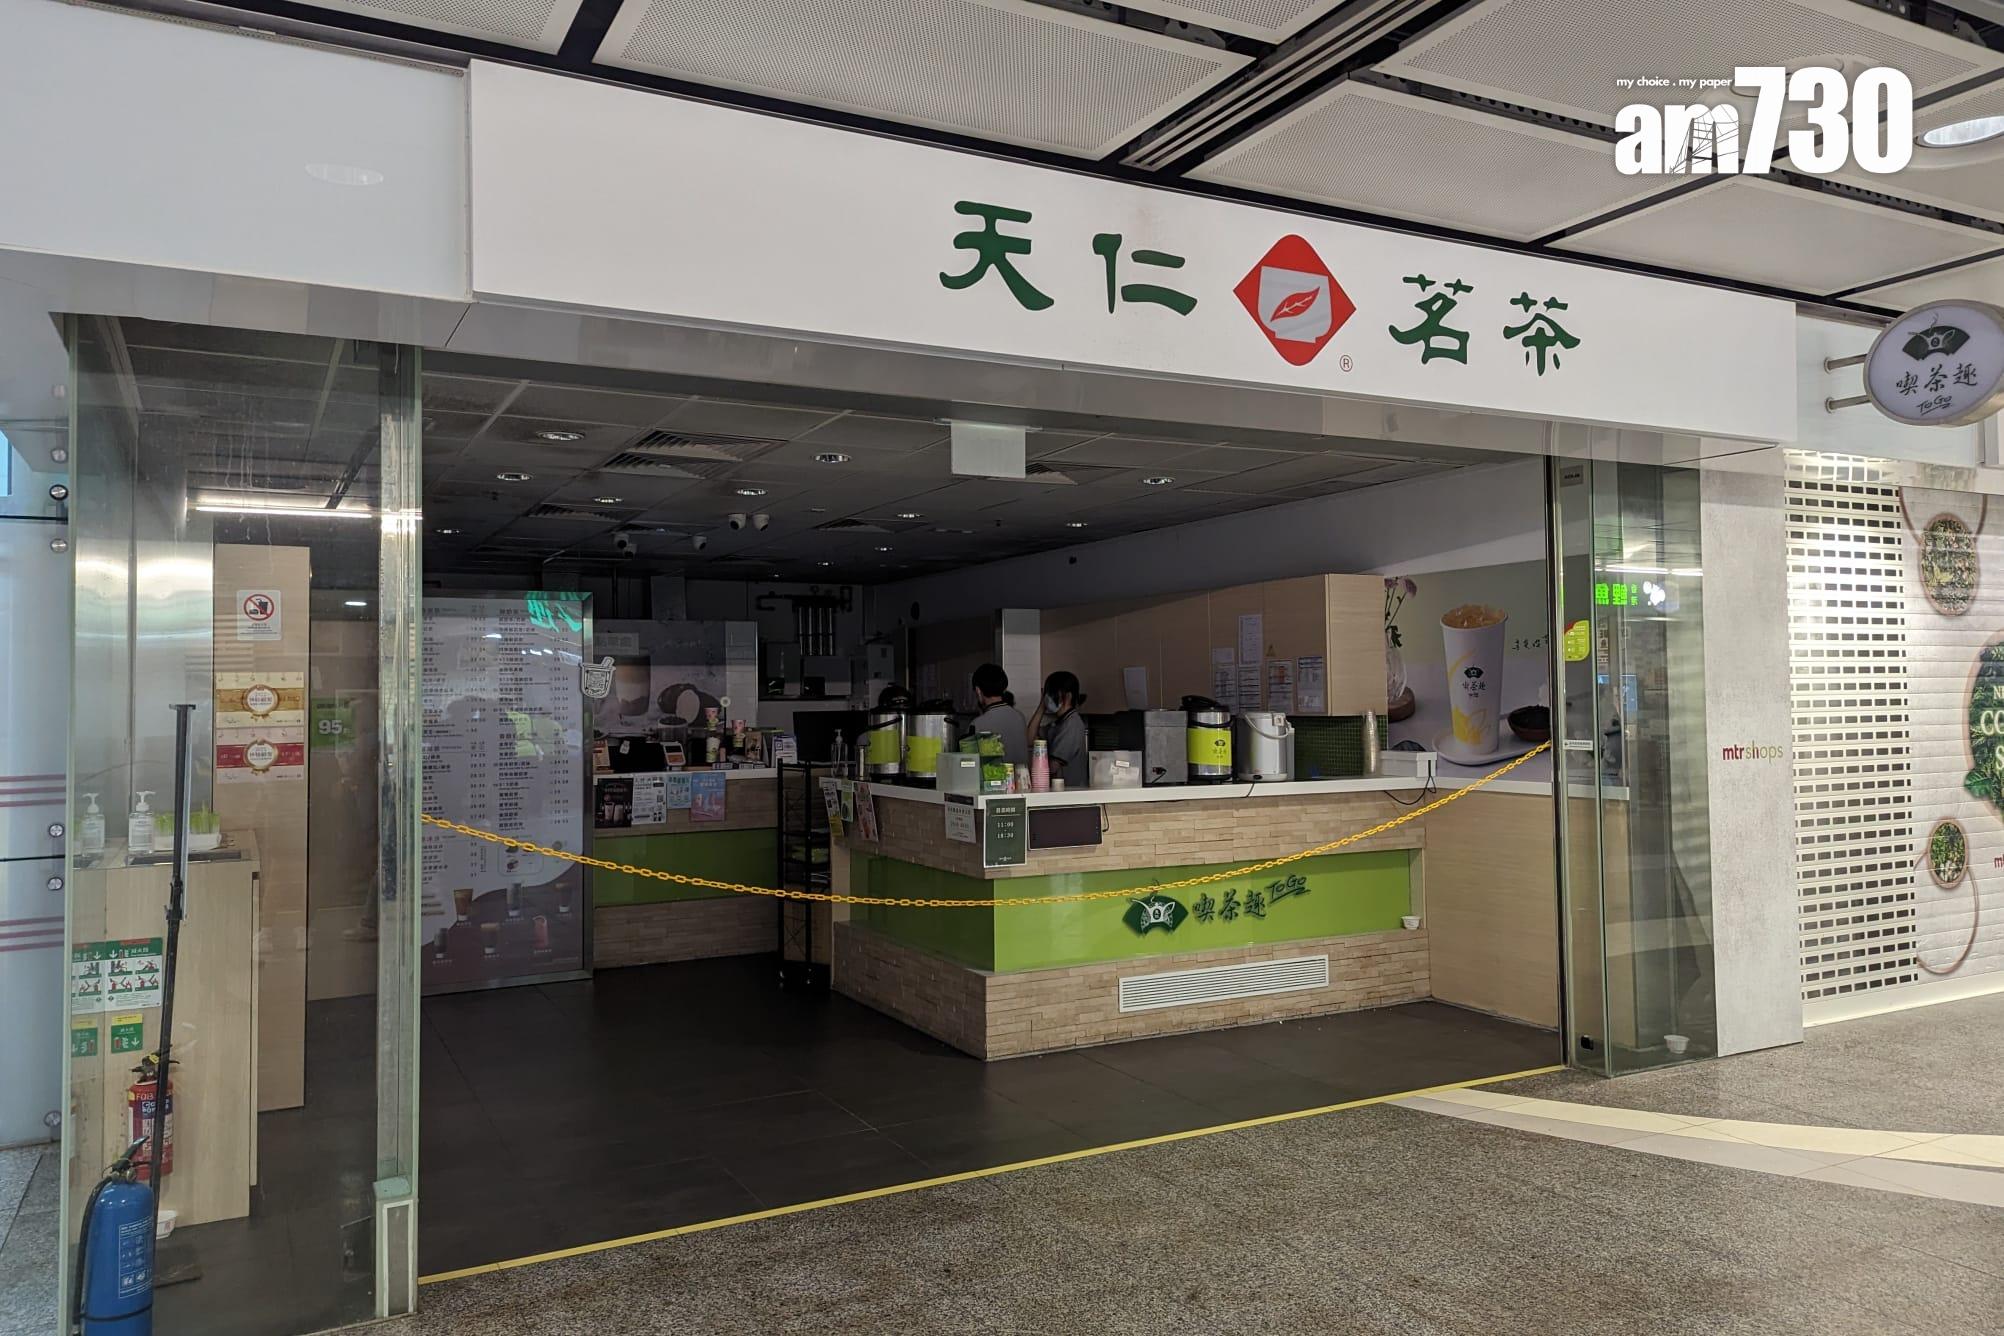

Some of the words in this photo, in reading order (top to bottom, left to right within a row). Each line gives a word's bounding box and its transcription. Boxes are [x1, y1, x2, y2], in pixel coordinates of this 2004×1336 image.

[940, 200, 1198, 316] 天仁
[1388, 274, 1582, 376] 茗茶
[1896, 363, 1978, 396] 喫茶趣
[318, 719, 343, 735] 95
[1192, 888, 1267, 922] 喫茶趣
